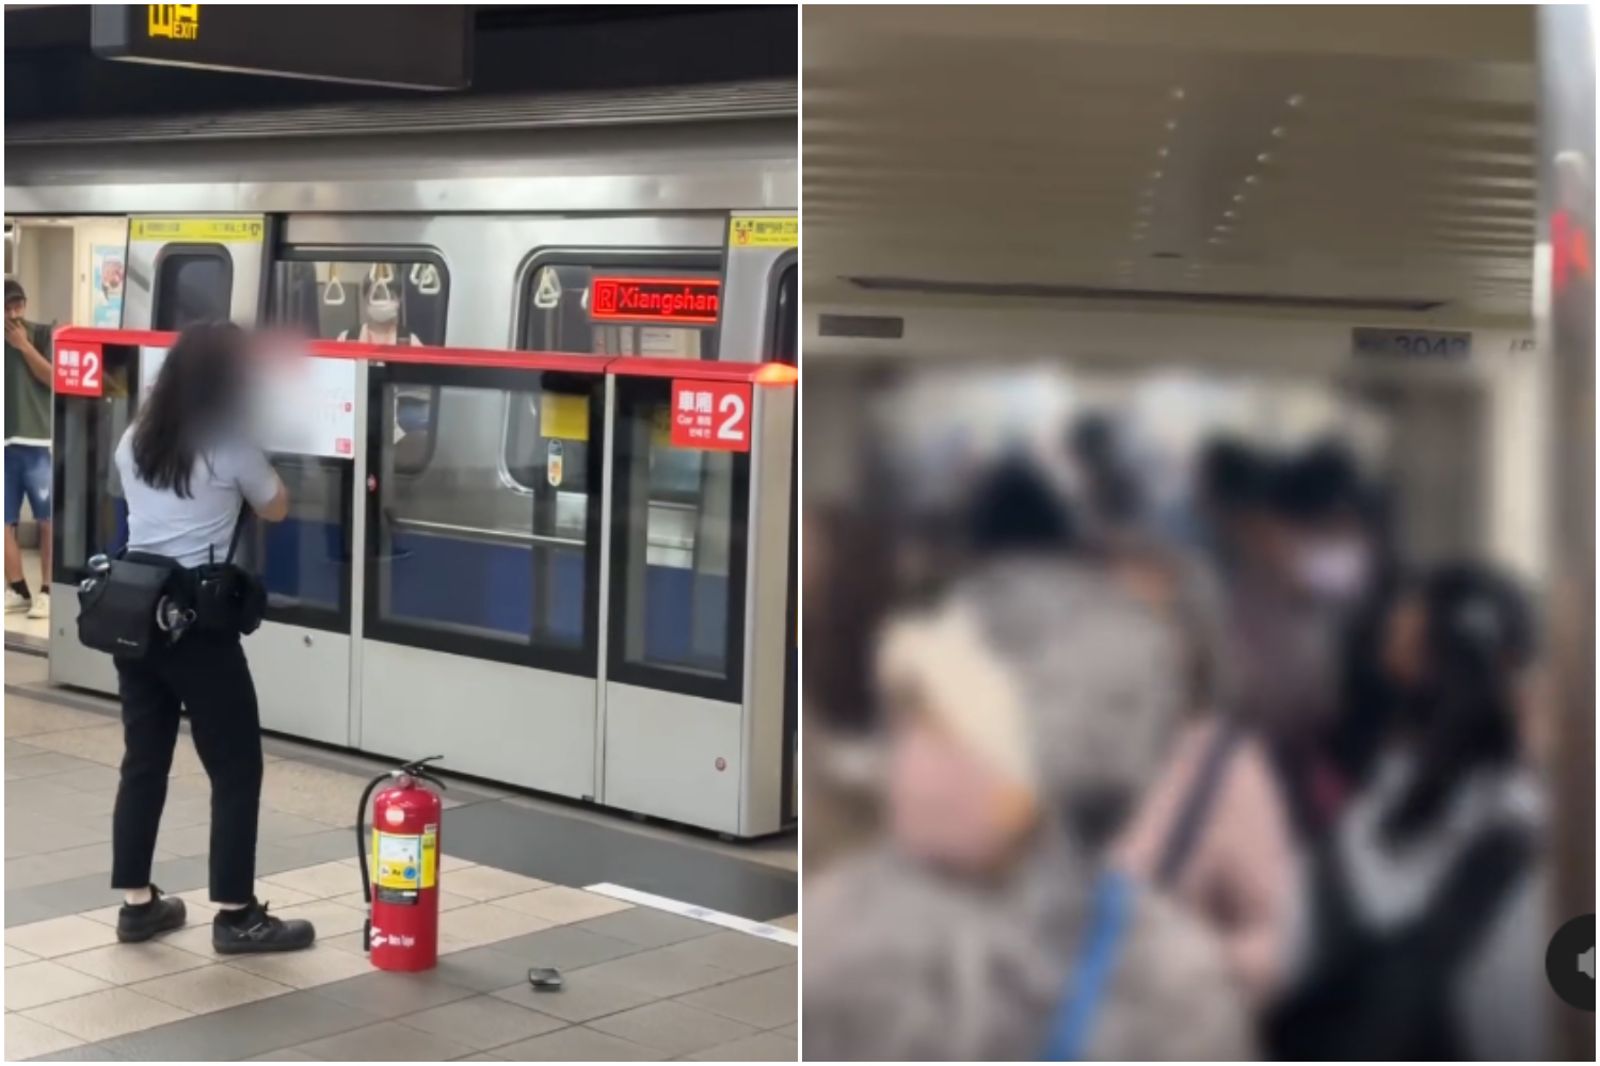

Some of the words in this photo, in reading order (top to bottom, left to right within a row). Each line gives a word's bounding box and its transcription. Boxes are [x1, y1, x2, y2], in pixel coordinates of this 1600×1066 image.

[174, 22, 198, 39] EXIT
[619, 287, 718, 315] Xiangshan
[82, 352, 99, 388] 2
[678, 390, 713, 413] 車廂
[676, 413, 694, 426] Car
[717, 393, 745, 440] 2
